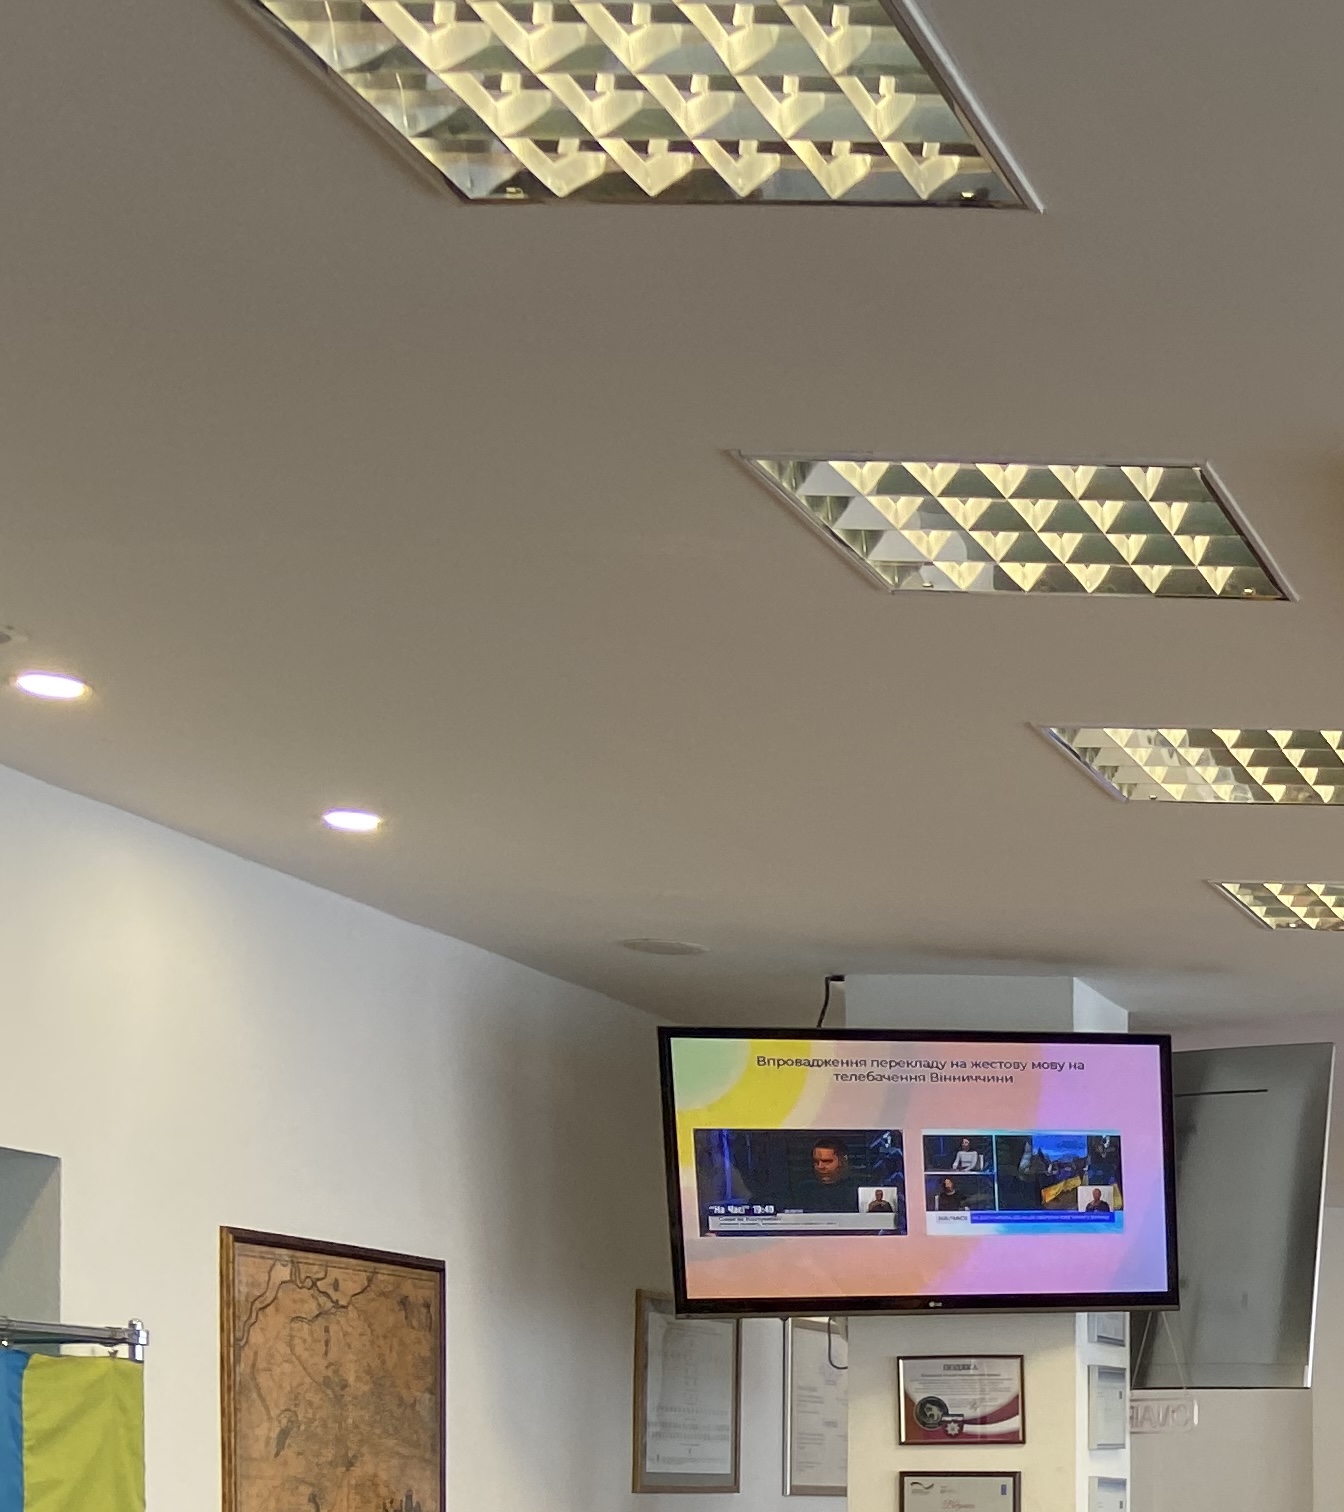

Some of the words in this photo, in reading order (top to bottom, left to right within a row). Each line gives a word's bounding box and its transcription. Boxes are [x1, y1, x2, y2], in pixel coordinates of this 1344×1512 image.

[757, 1056, 867, 1070] Впровадження
[870, 1057, 947, 1071] перекладу
[950, 1060, 967, 1069] на
[970, 1060, 1029, 1071] жестову
[1031, 1060, 1066, 1072] мову
[1068, 1061, 1085, 1070] на
[833, 1071, 926, 1083] телебачення
[930, 1072, 1014, 1084] Вінниччини
